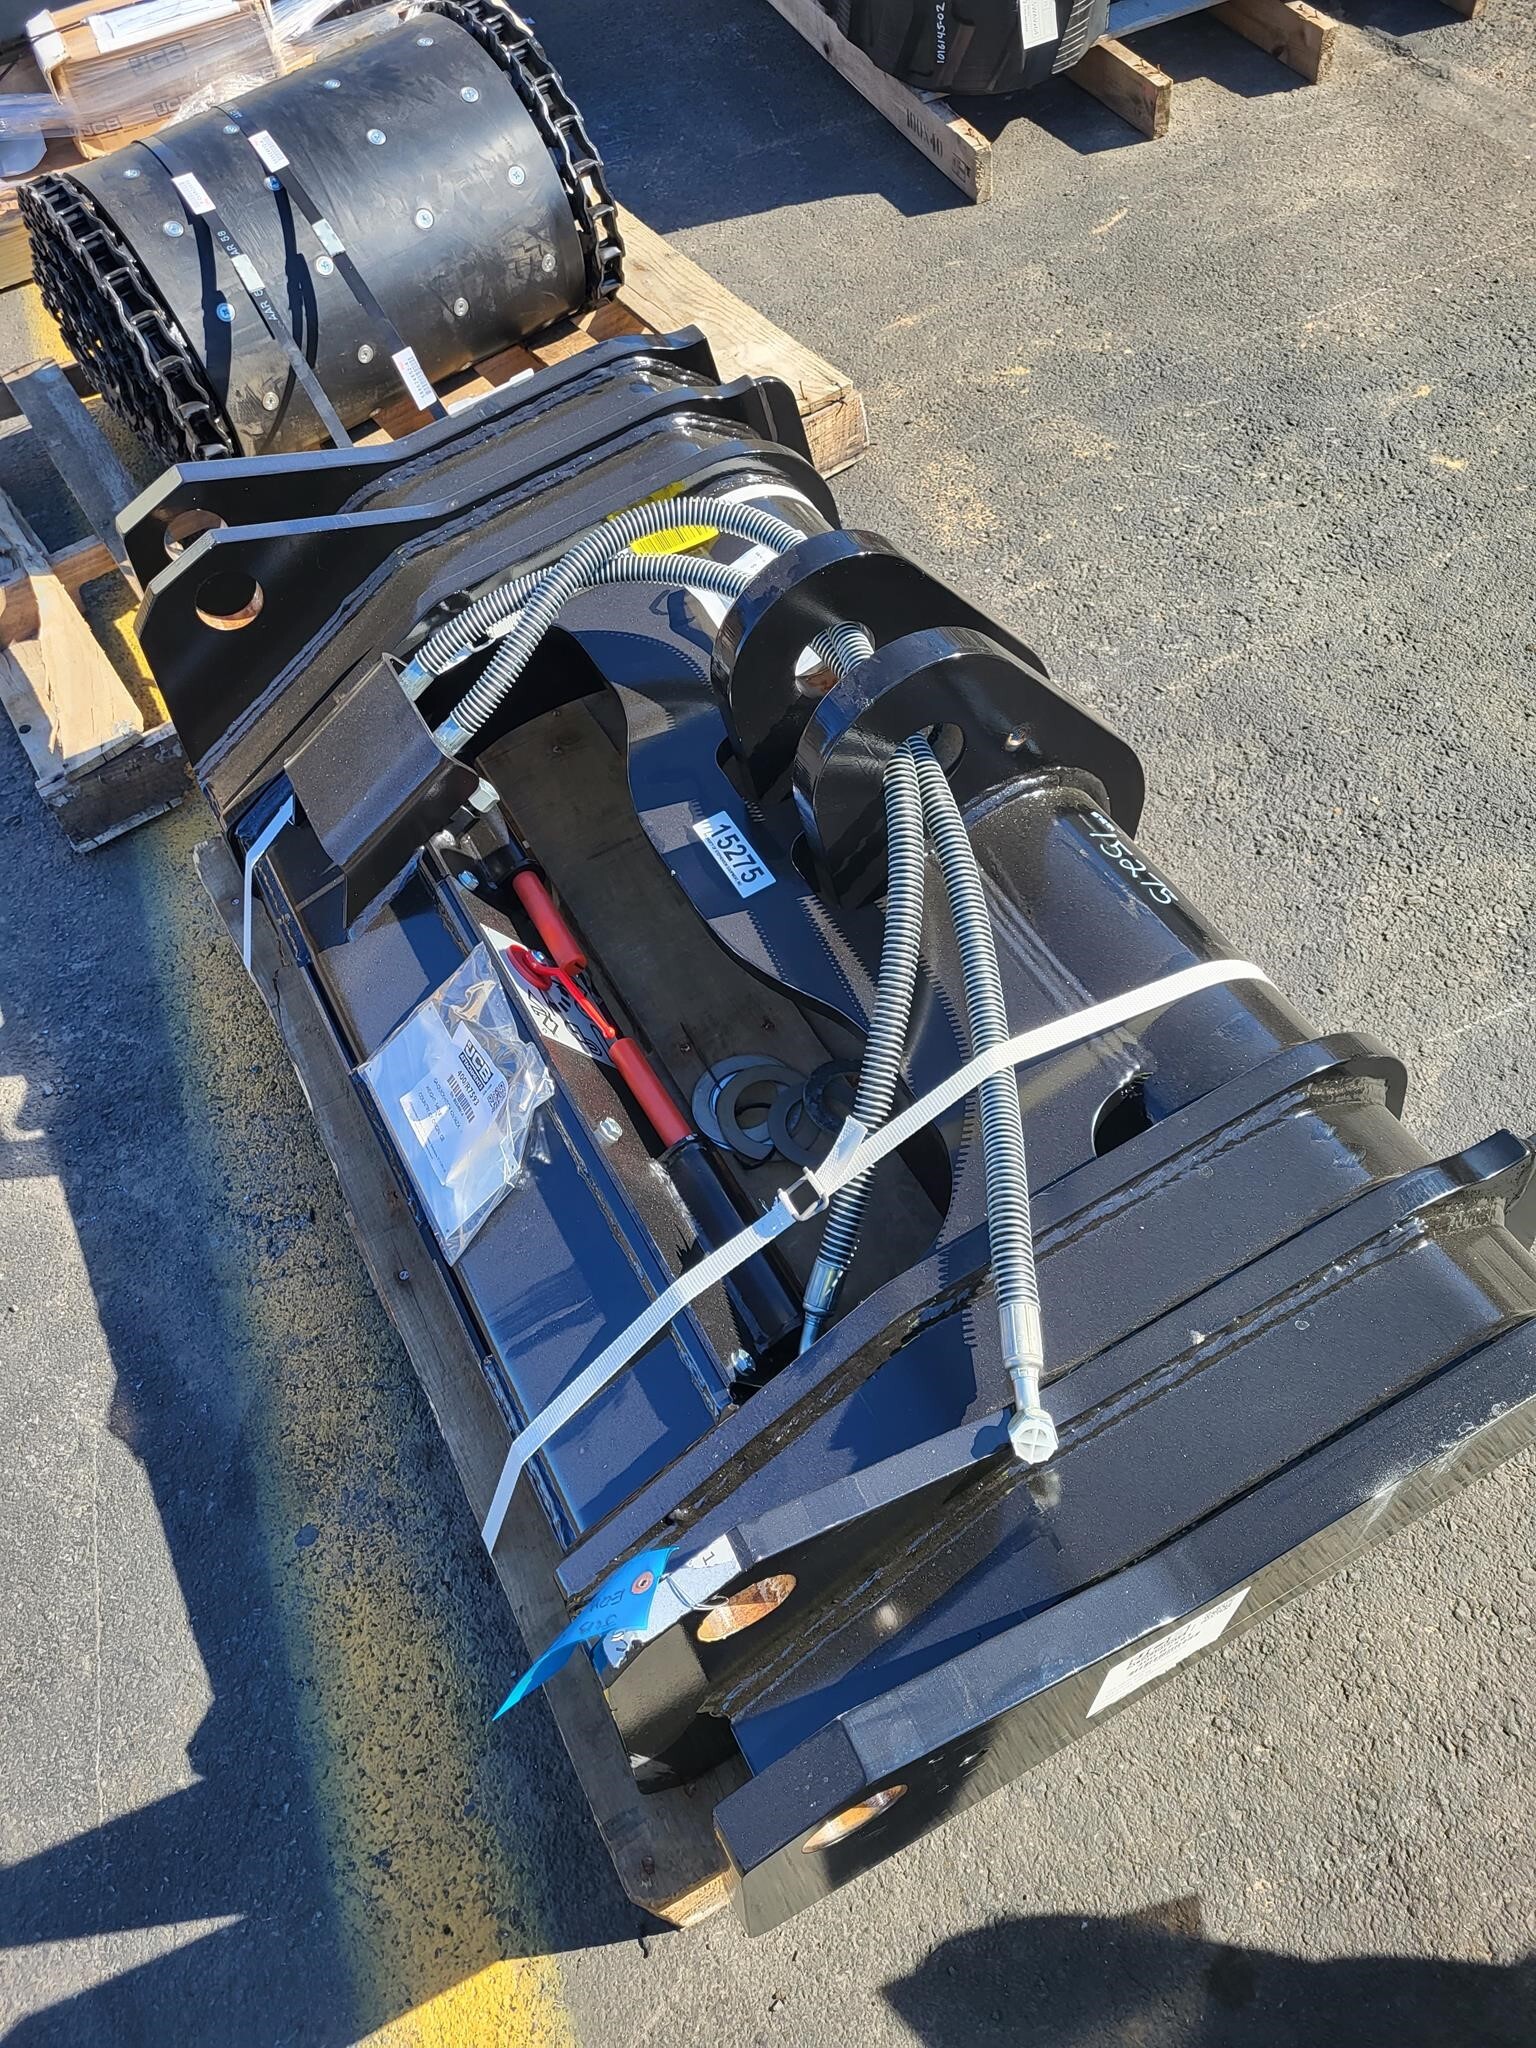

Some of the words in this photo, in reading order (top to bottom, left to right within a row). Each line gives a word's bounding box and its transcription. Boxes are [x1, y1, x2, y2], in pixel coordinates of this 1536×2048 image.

[711, 824, 765, 882] 15275
[1089, 832, 1179, 905] 15275
[464, 1040, 494, 1085] JCB
